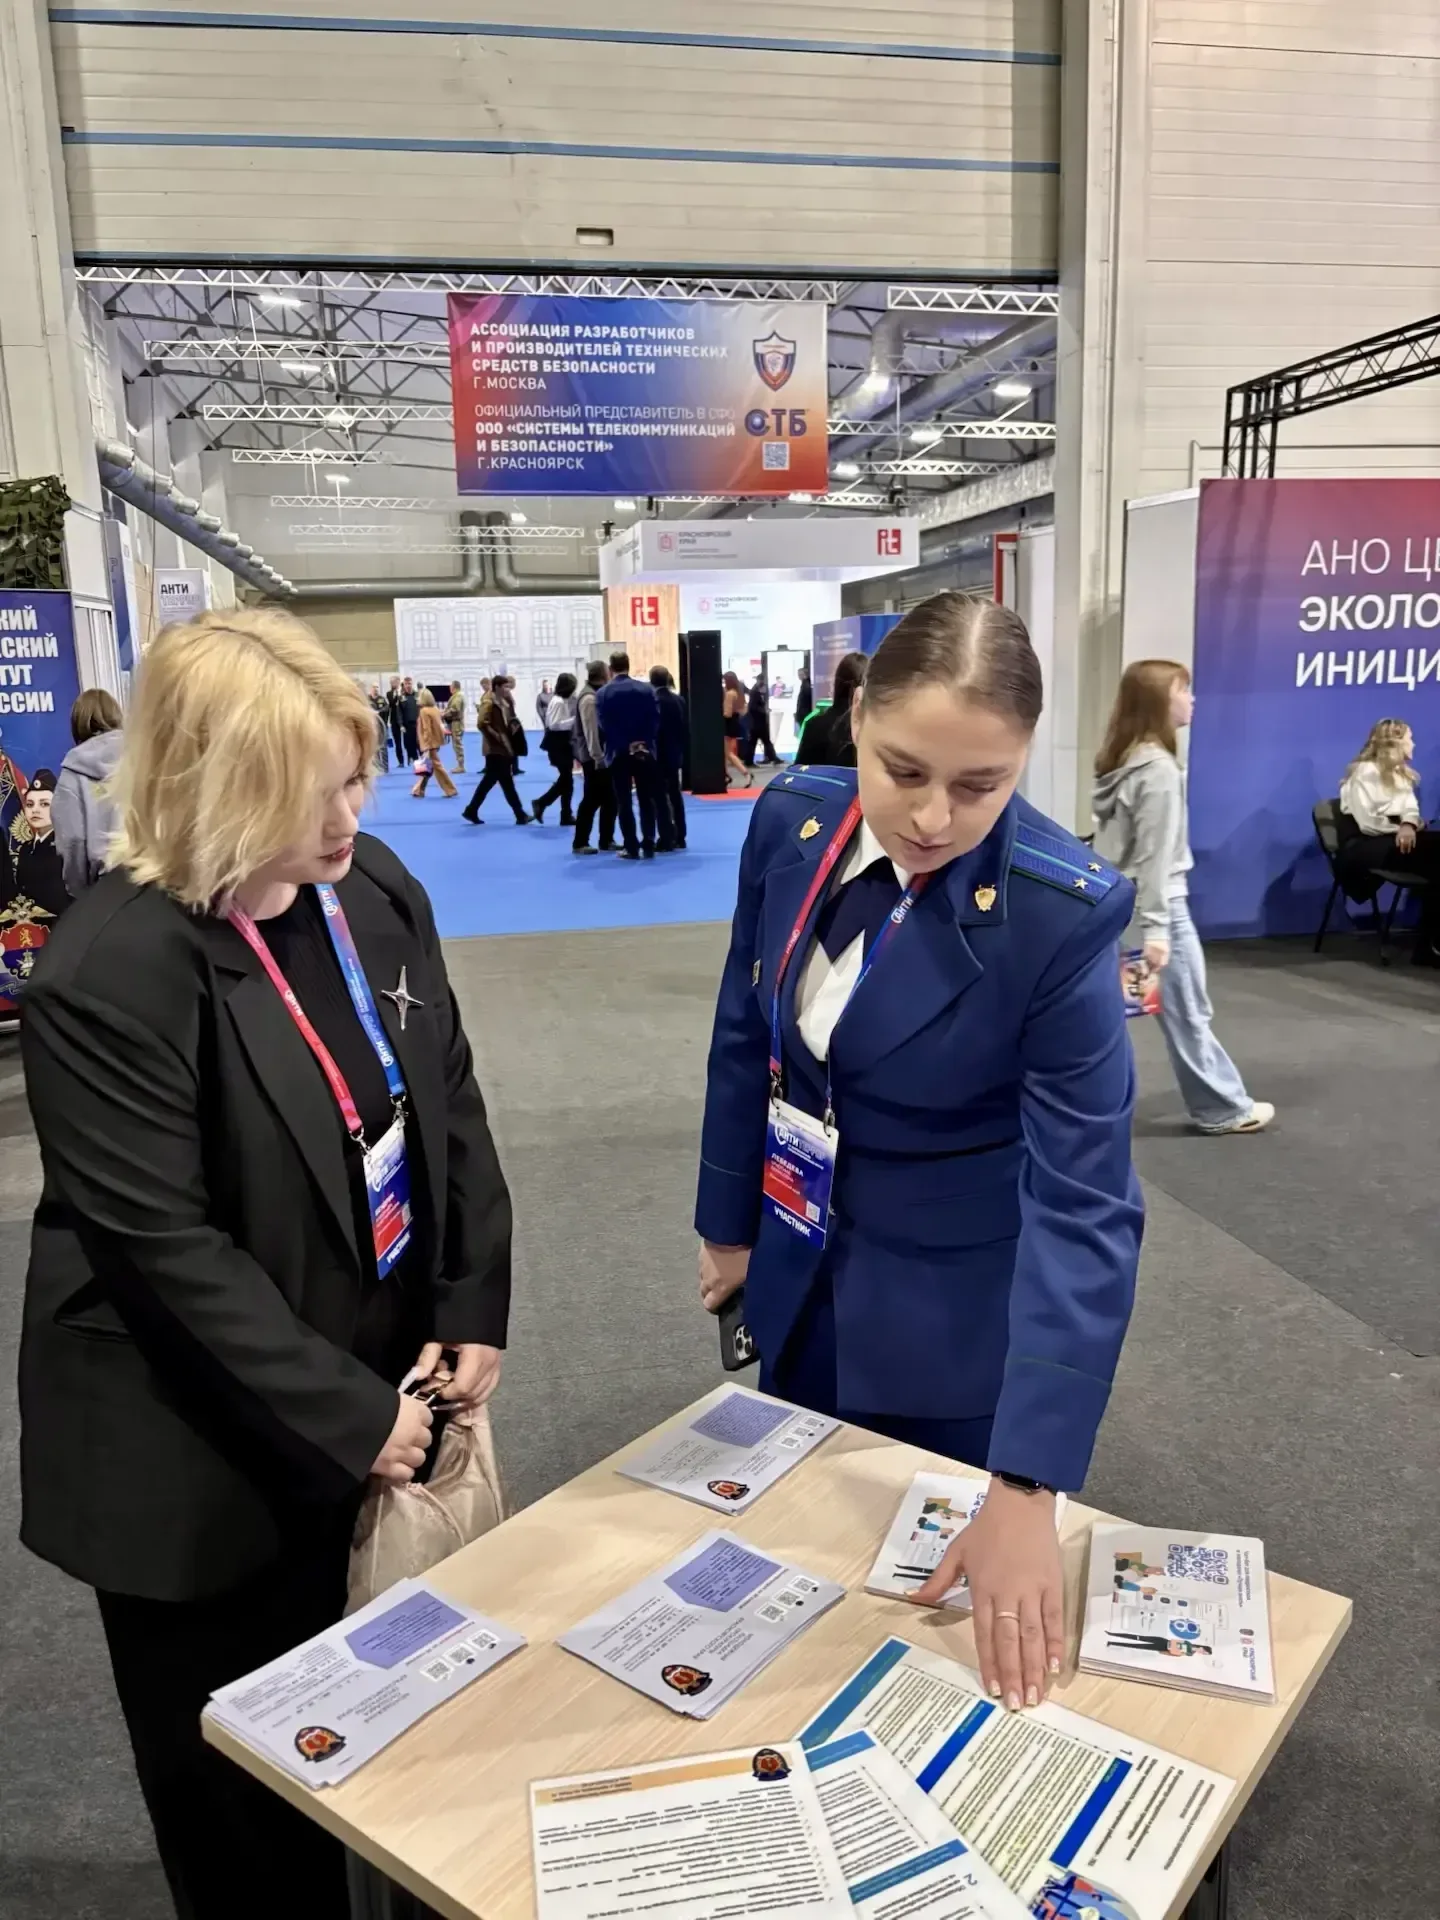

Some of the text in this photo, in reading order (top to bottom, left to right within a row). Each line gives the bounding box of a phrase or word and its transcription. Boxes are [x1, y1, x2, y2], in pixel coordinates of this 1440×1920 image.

[470, 323, 695, 341] АССОЦИАЦИЯ РАЗРАБОТЧИКОВ
[472, 340, 729, 359] И ПРОИЗВОДИТЕЛЕЙ ТЕХНИЧЕСКИХ
[472, 359, 656, 375] СРЕДСТВ БЕЗОПАСНОСТИ
[473, 376, 546, 391] Г.МОСКВА
[475, 403, 581, 419] ОФИЦИАЛЬНЫЙ
[585, 405, 694, 420] ПРЕДСТАВИТЕЛЬ
[697, 407, 705, 419] В
[475, 421, 735, 437] ООО «СИСТЕМЫ ТЕЛЕКОММУНИКАЦИЙ
[744, 409, 807, 437] СТБ
[477, 440, 613, 453] И БЕЗОПАСНОСТИ»
[478, 457, 585, 471] Г.КРАСНОЯРСК
[1301, 536, 1440, 582] АНО Ц
[160, 583, 189, 595] АНТИ
[1298, 592, 1440, 633] ЭКОЛО
[0, 632, 58, 658] СКИЙ
[1295, 648, 1440, 692] ИНИЦИ
[773, 1205, 812, 1238] УЧАСТНИК
